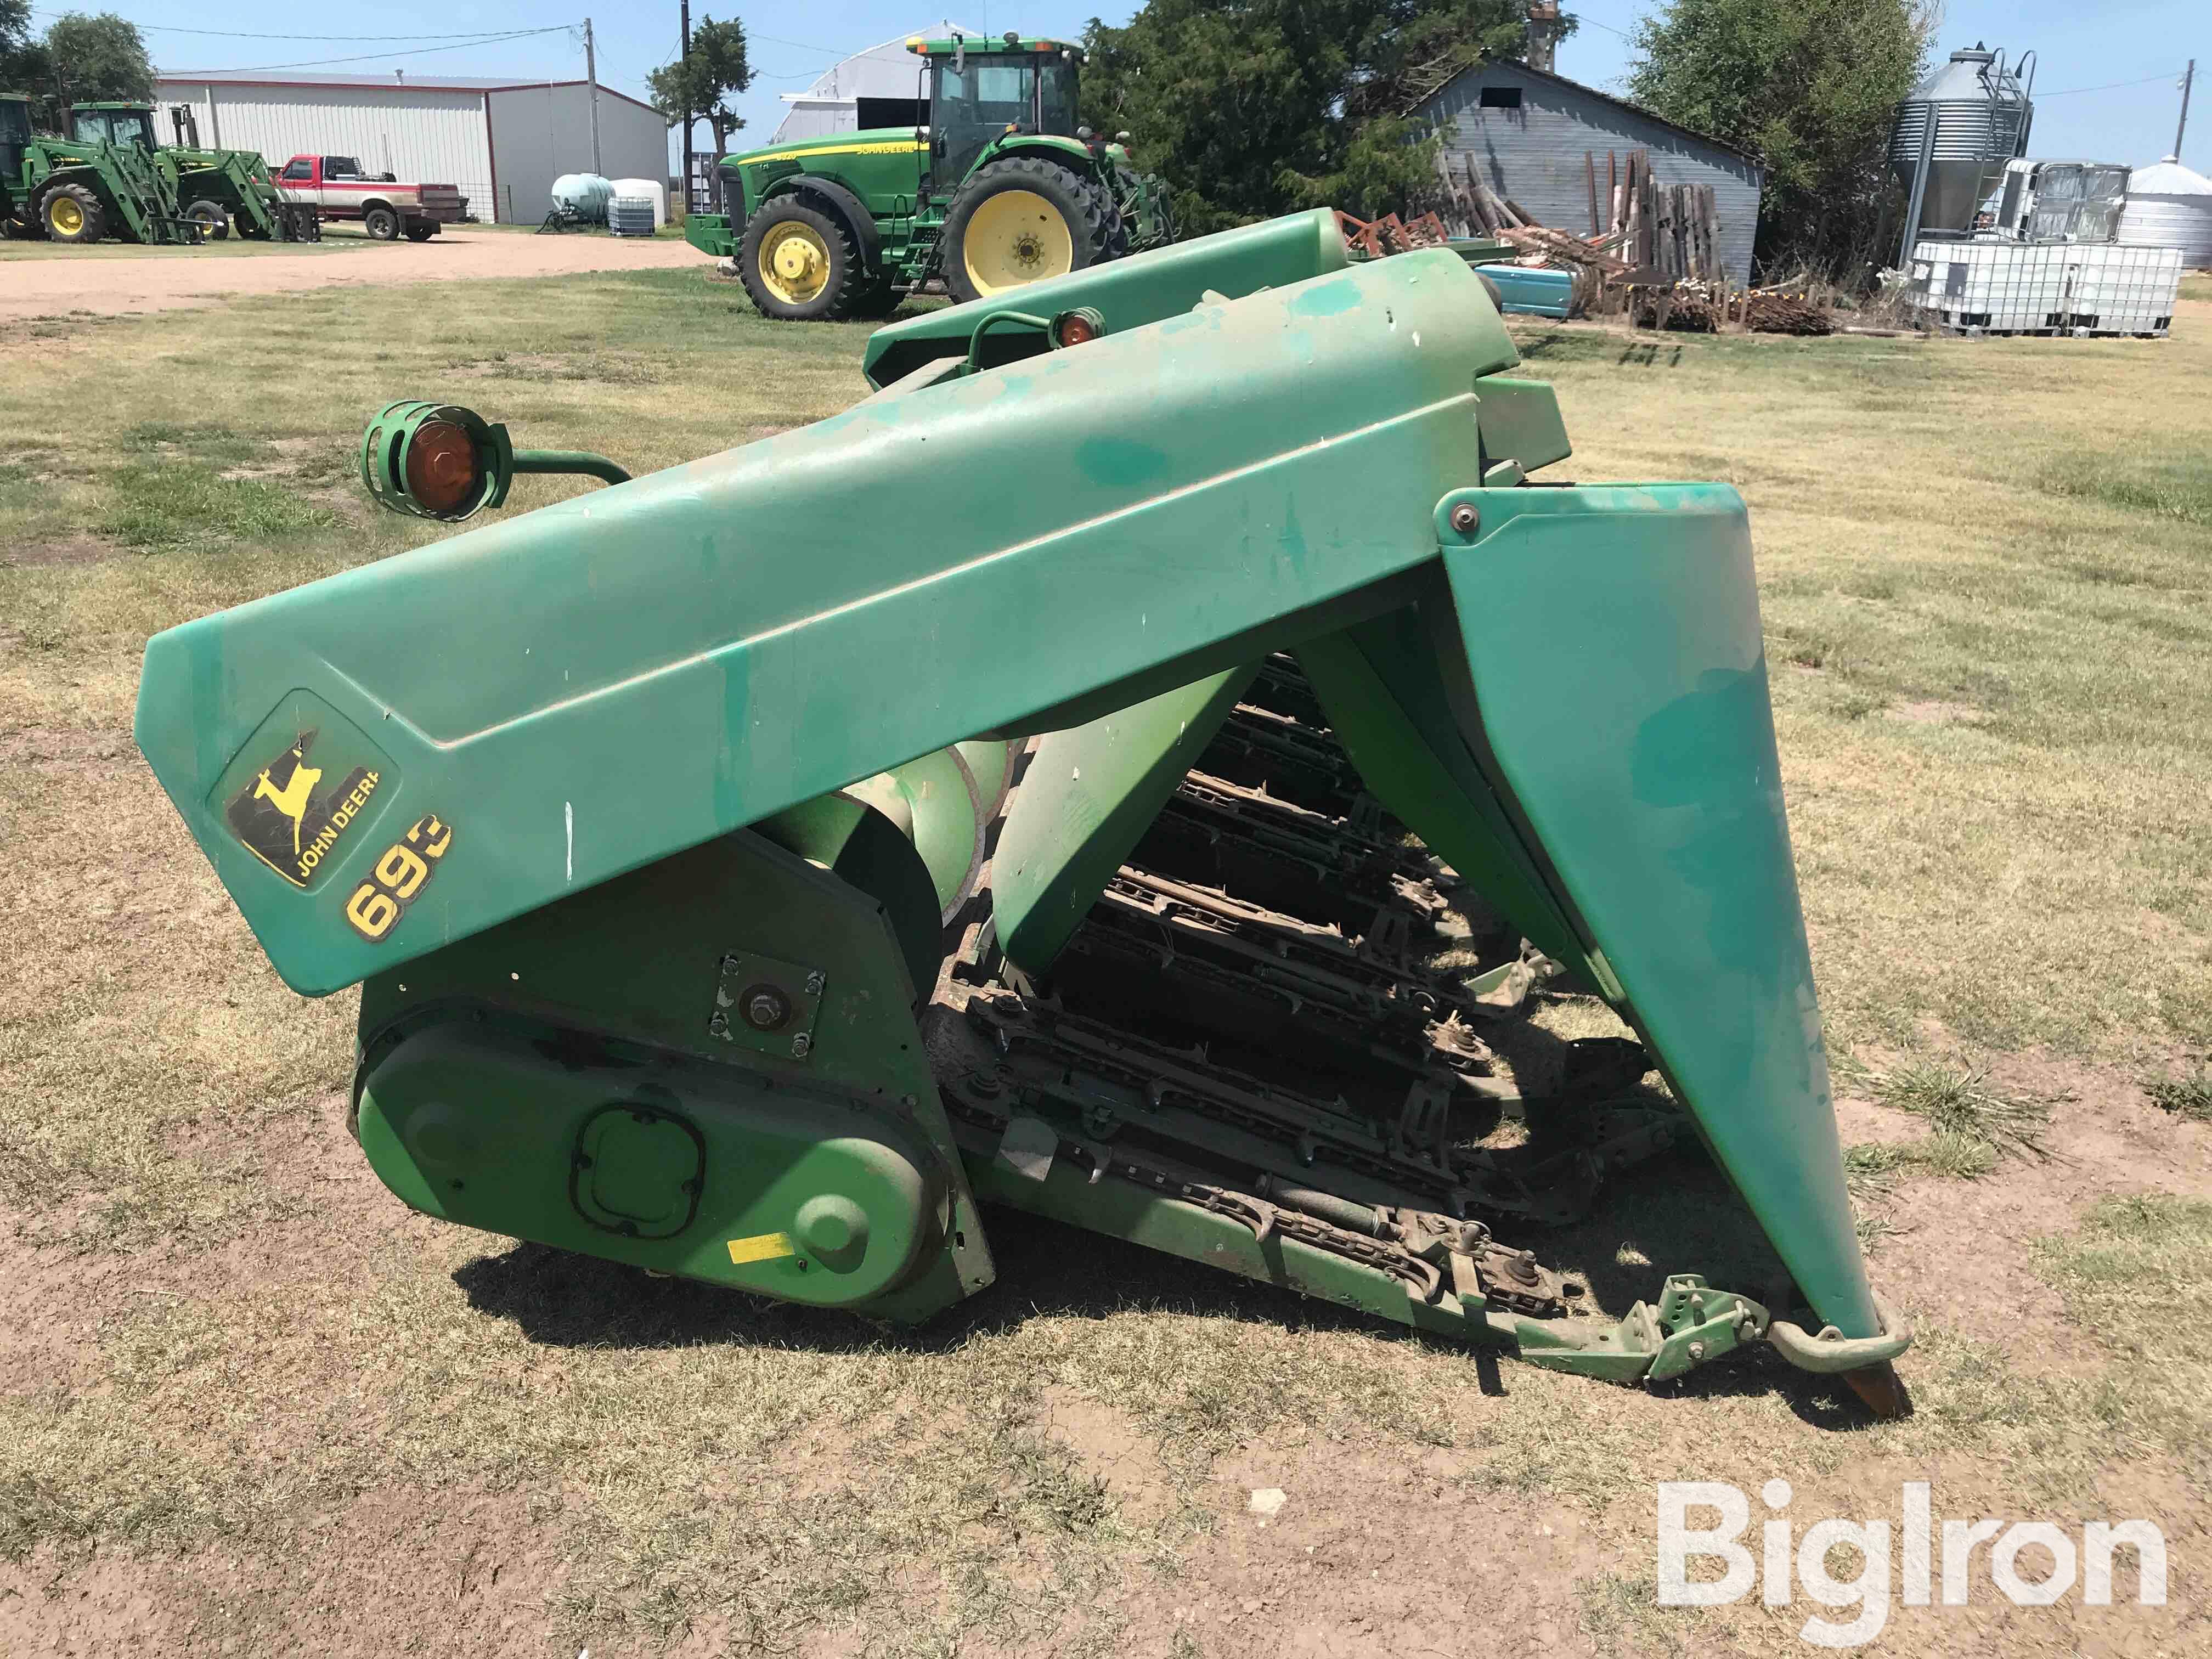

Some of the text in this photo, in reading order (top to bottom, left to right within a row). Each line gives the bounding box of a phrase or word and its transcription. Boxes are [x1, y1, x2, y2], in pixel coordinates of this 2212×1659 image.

[856, 143, 915, 155] JOHN DEERE
[297, 825, 338, 877] JOHN
[346, 814, 452, 937] 693
